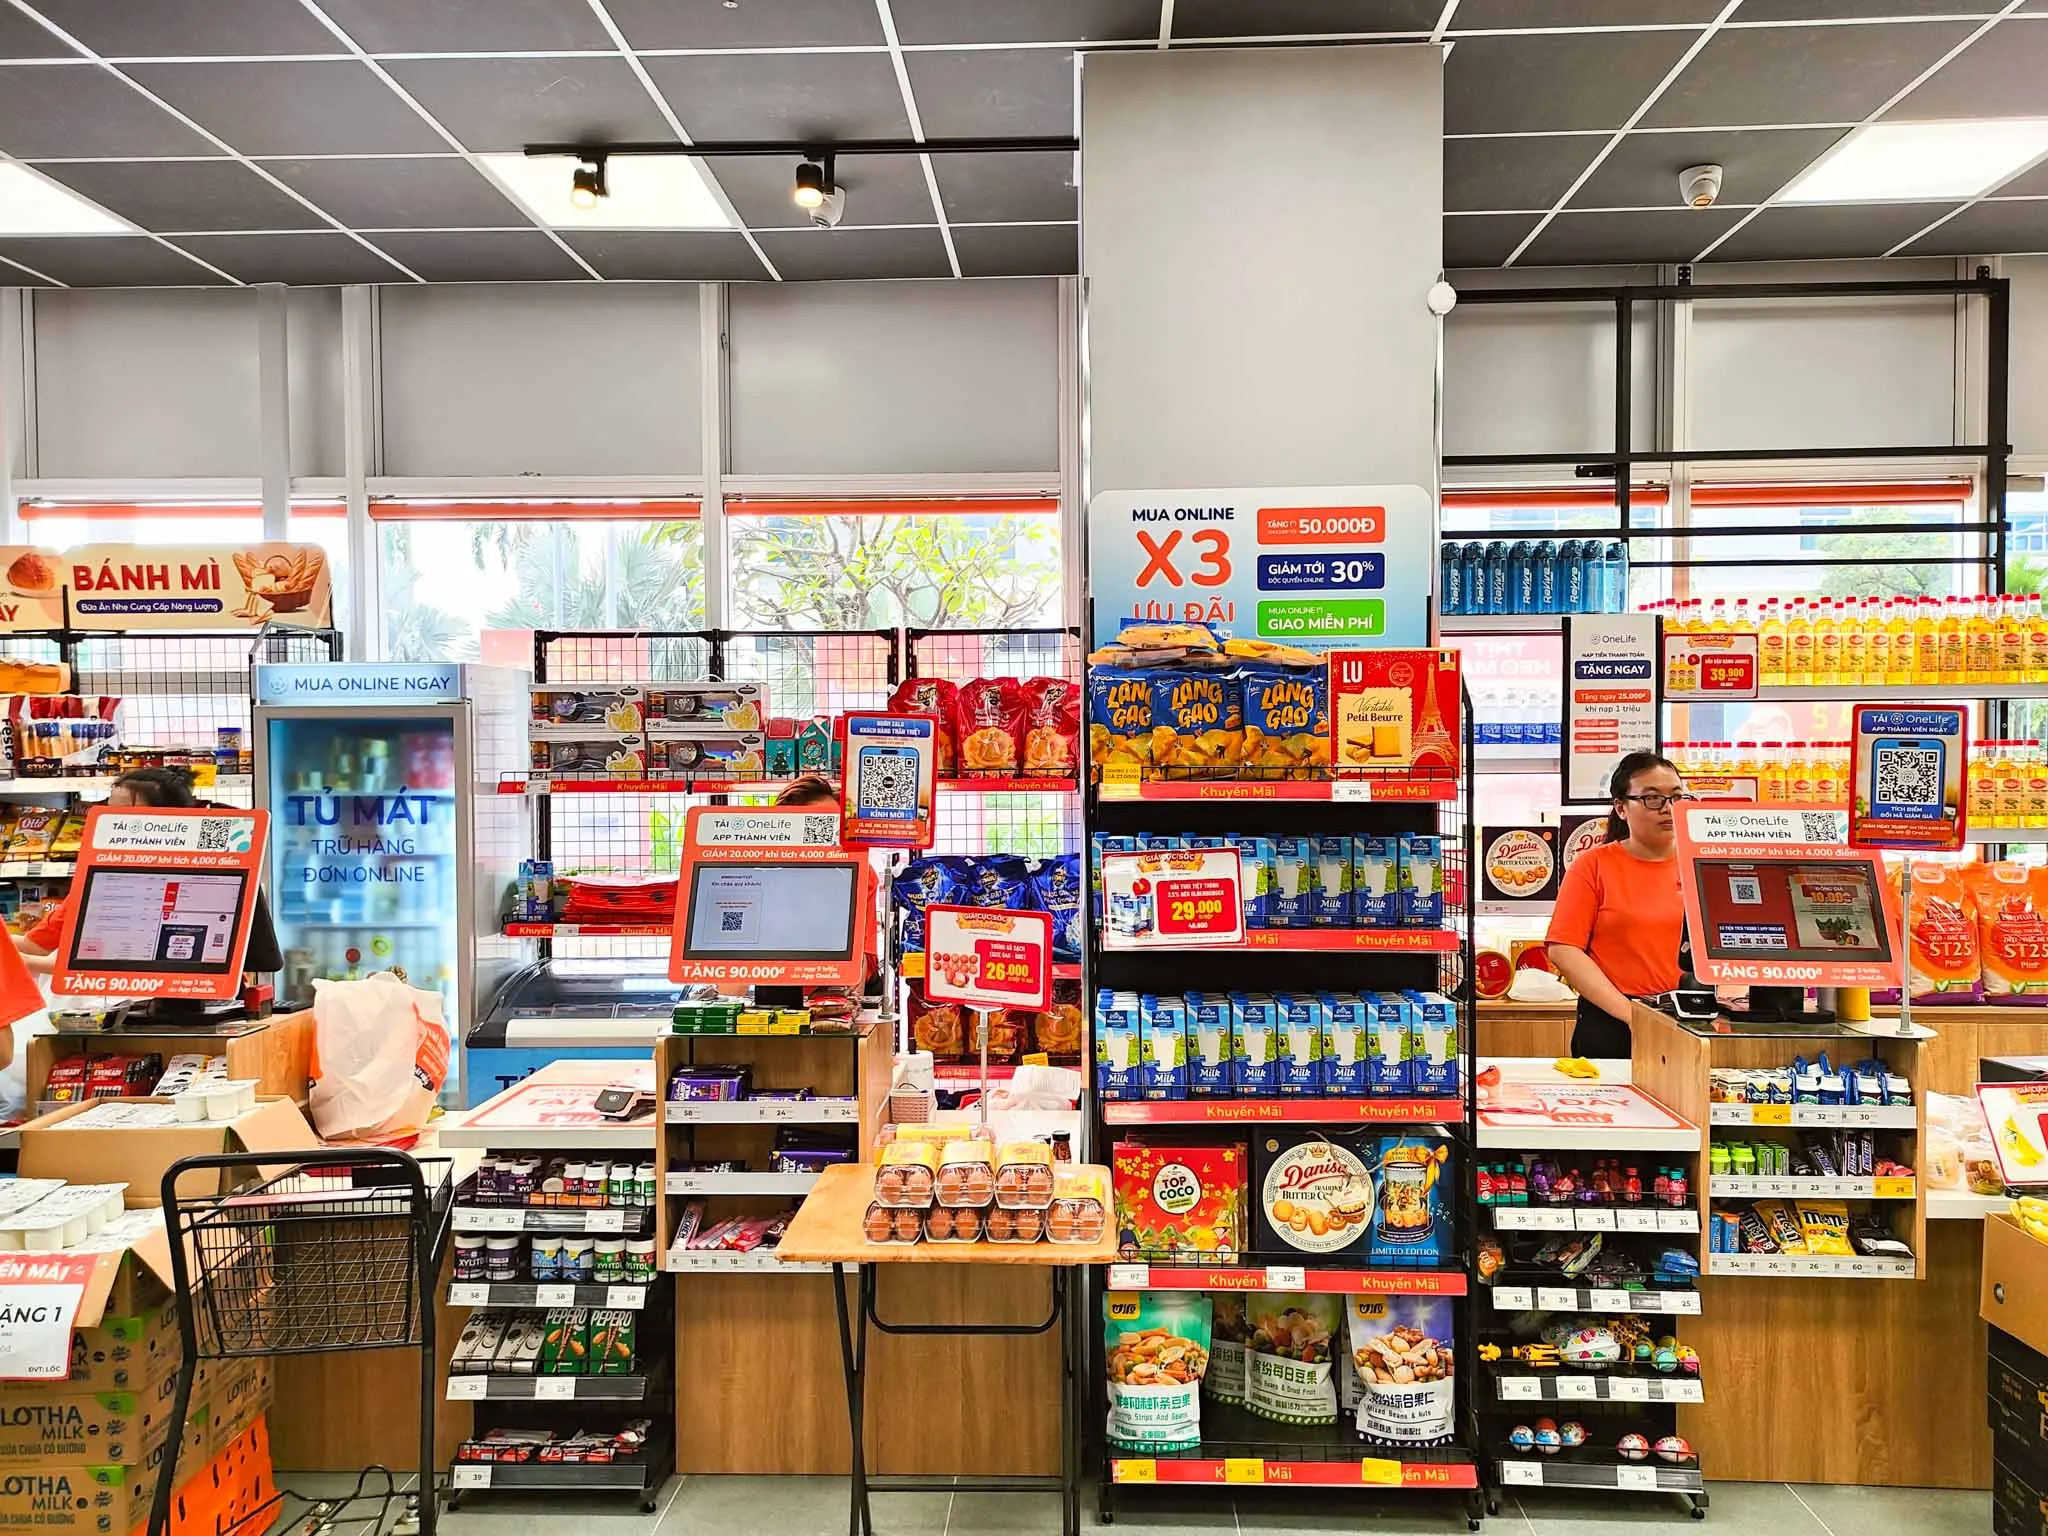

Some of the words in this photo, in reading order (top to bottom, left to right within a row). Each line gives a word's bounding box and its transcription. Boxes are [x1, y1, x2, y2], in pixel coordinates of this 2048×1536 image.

[1132, 509, 1170, 522] MUA
[1174, 507, 1235, 521] ONLINE
[1135, 528, 1234, 589] X3
[72, 557, 170, 591] BÁNH
[180, 556, 221, 590] MÌ
[1268, 561, 1301, 575] GIẢM
[1303, 560, 1325, 575] TỚI
[1330, 560, 1375, 583] 30%
[130, 603, 151, 612] Cung
[1183, 597, 1236, 622] ĐÃI
[1268, 607, 1287, 615] MUA
[1268, 618, 1305, 630] GIAO
[1308, 612, 1344, 630] MIỄN
[1348, 614, 1374, 629] PHÍ
[1602, 635, 1637, 645] OneLife
[1342, 661, 1364, 684] LU
[1581, 664, 1612, 677] TẶNG
[1614, 665, 1645, 675] NGAY
[294, 678, 334, 691] MUA
[338, 676, 399, 690] ONLINE
[404, 676, 451, 691] NGAY
[1171, 677, 1223, 710] LÀNG
[1261, 678, 1315, 709] LÀNG
[1585, 705, 1597, 713] khi
[1621, 704, 1641, 713] triệu
[1346, 712, 1370, 723] Petit
[1371, 712, 1404, 722] Beurre
[288, 786, 340, 825] TỦ
[353, 786, 437, 825] MÁT
[112, 822, 127, 831] TẢI
[144, 822, 188, 833] OneLife
[714, 820, 729, 828] TẢI
[747, 819, 792, 829] OneLife
[1704, 816, 1721, 825] TẢI
[1740, 815, 1789, 826] OneLife
[713, 833, 732, 841] APP
[735, 833, 766, 841] THÀNH
[769, 833, 791, 841] VIÊN
[1707, 831, 1727, 839] APP
[1729, 829, 1766, 839] THÀNH
[1770, 829, 1792, 839] VIÊN
[312, 834, 351, 855] TRỮ
[357, 838, 415, 855] HÀNG
[1769, 847, 1783, 856] khi
[1805, 847, 1833, 857] 4.000
[765, 850, 780, 858] khi
[799, 850, 825, 859] 4.000
[303, 866, 348, 883] ĐƠN
[353, 866, 425, 882] ONLINE
[1170, 898, 1223, 921] 29.000
[519, 926, 553, 936] Khuyến
[1256, 934, 1279, 945] Mãi
[1928, 941, 1972, 957] ST25
[2003, 943, 2048, 958] ST25
[682, 962, 726, 981] TẶNG
[985, 961, 1030, 981] 26.000
[1710, 962, 1759, 981] TẶNG
[1200, 1066, 1220, 1078] Milk
[1244, 1067, 1266, 1079] Milk
[1289, 1066, 1311, 1078] Milk
[1206, 1102, 1256, 1119] Khuyến
[1260, 1103, 1283, 1117] Mãi
[1360, 1102, 1409, 1118] Khuyến
[1413, 1103, 1437, 1117] Mãi
[1162, 1176, 1187, 1189] TOP
[1160, 1185, 1195, 1200] COCO
[1282, 1190, 1316, 1201] BUTTER
[1516, 1215, 1526, 1223] 35
[1555, 1216, 1565, 1224] 35
[1405, 1248, 1439, 1256] EDITION
[1730, 1261, 1740, 1269] 34
[1209, 1274, 1258, 1289] Khuyến
[1362, 1277, 1412, 1291] Khuyến
[1417, 1277, 1440, 1290] Mãi
[1558, 1296, 1568, 1304] 39
[54, 1306, 62, 1322] 1
[545, 1307, 588, 1325] PEPERO
[590, 1310, 632, 1327] PEPERO
[1, 1405, 84, 1426] LOTHA
[42, 1425, 84, 1441] MILK
[473, 1473, 482, 1481] 39
[1268, 1468, 1293, 1481] Mãi
[32, 1496, 73, 1511] MILK
